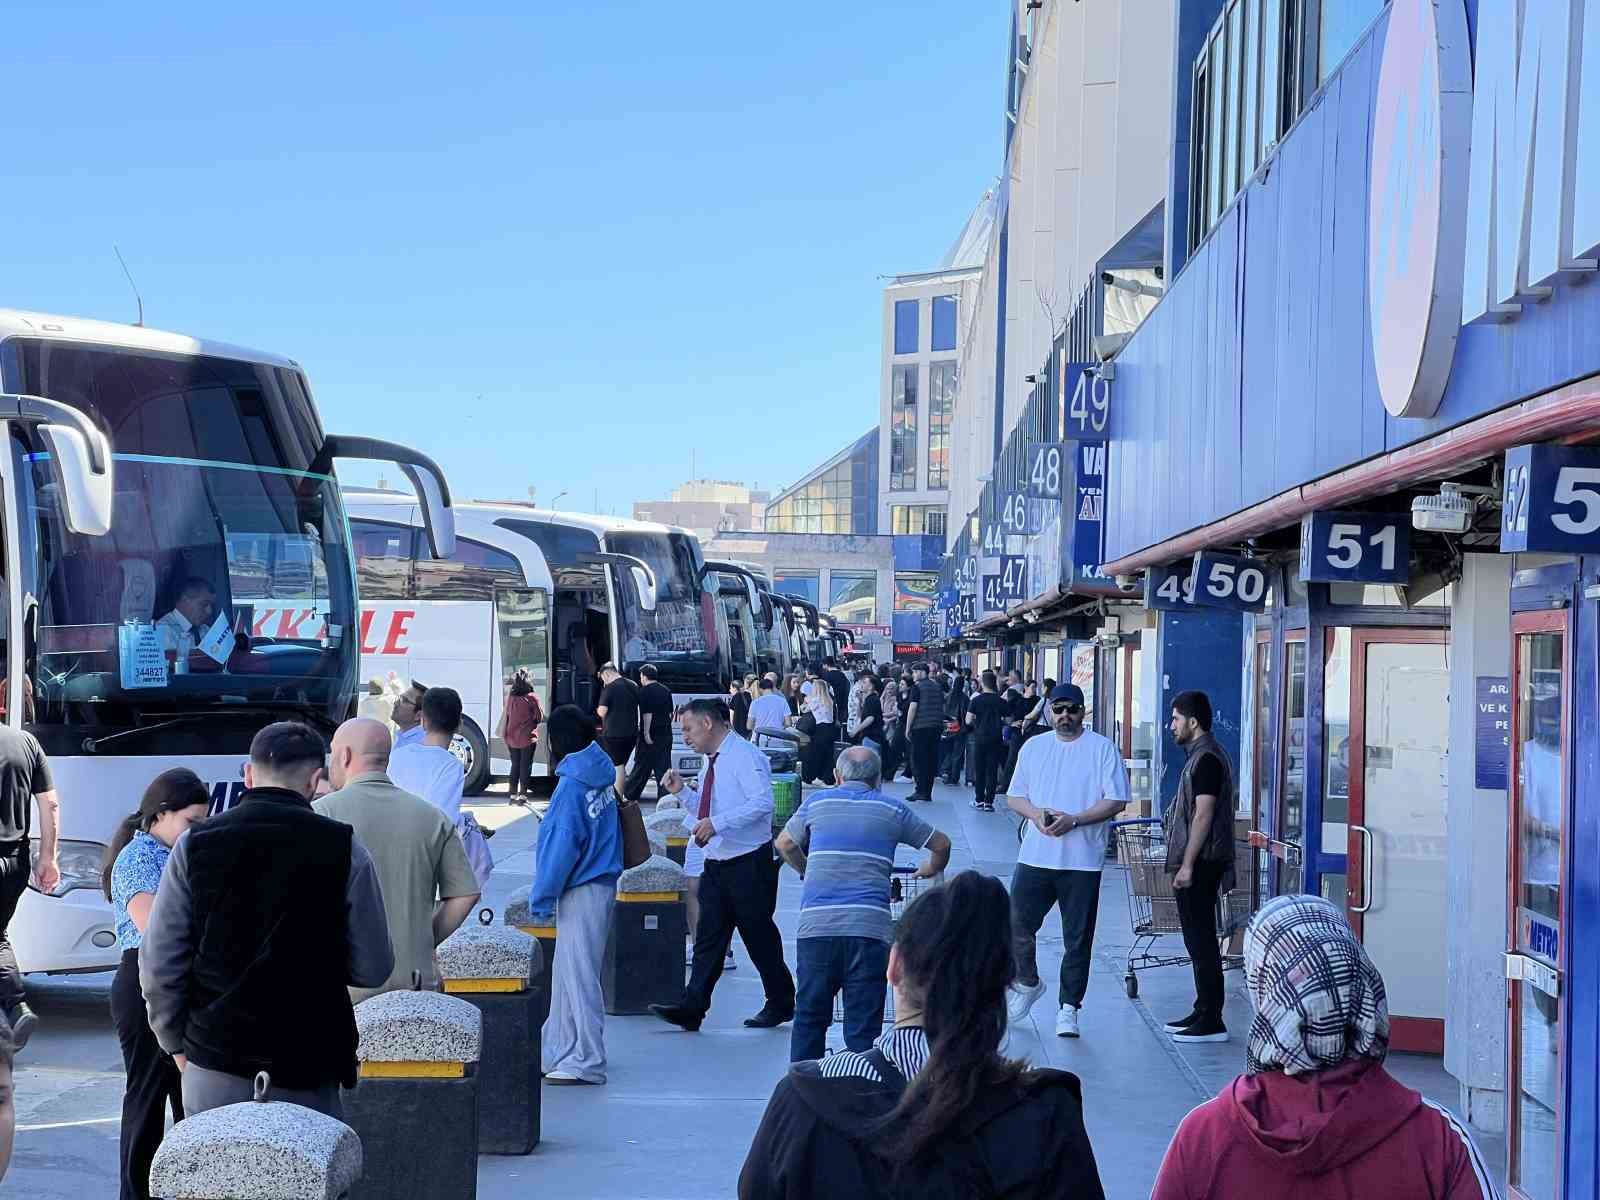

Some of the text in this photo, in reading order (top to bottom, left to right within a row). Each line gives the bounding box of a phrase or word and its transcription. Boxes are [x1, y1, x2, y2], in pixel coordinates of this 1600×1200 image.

[1070, 371, 1109, 432] 49
[1031, 447, 1060, 494] 48
[1003, 494, 1025, 530] 46
[1504, 465, 1528, 532] 52
[984, 524, 1003, 554] 44
[1326, 523, 1396, 570] 51
[962, 558, 977, 580] 40
[1003, 558, 1025, 595] 47
[1206, 562, 1265, 602] 50
[948, 605, 961, 626] 33
[963, 597, 977, 620] 41
[1480, 703, 1495, 713] VE
[1529, 919, 1559, 961] METRO
